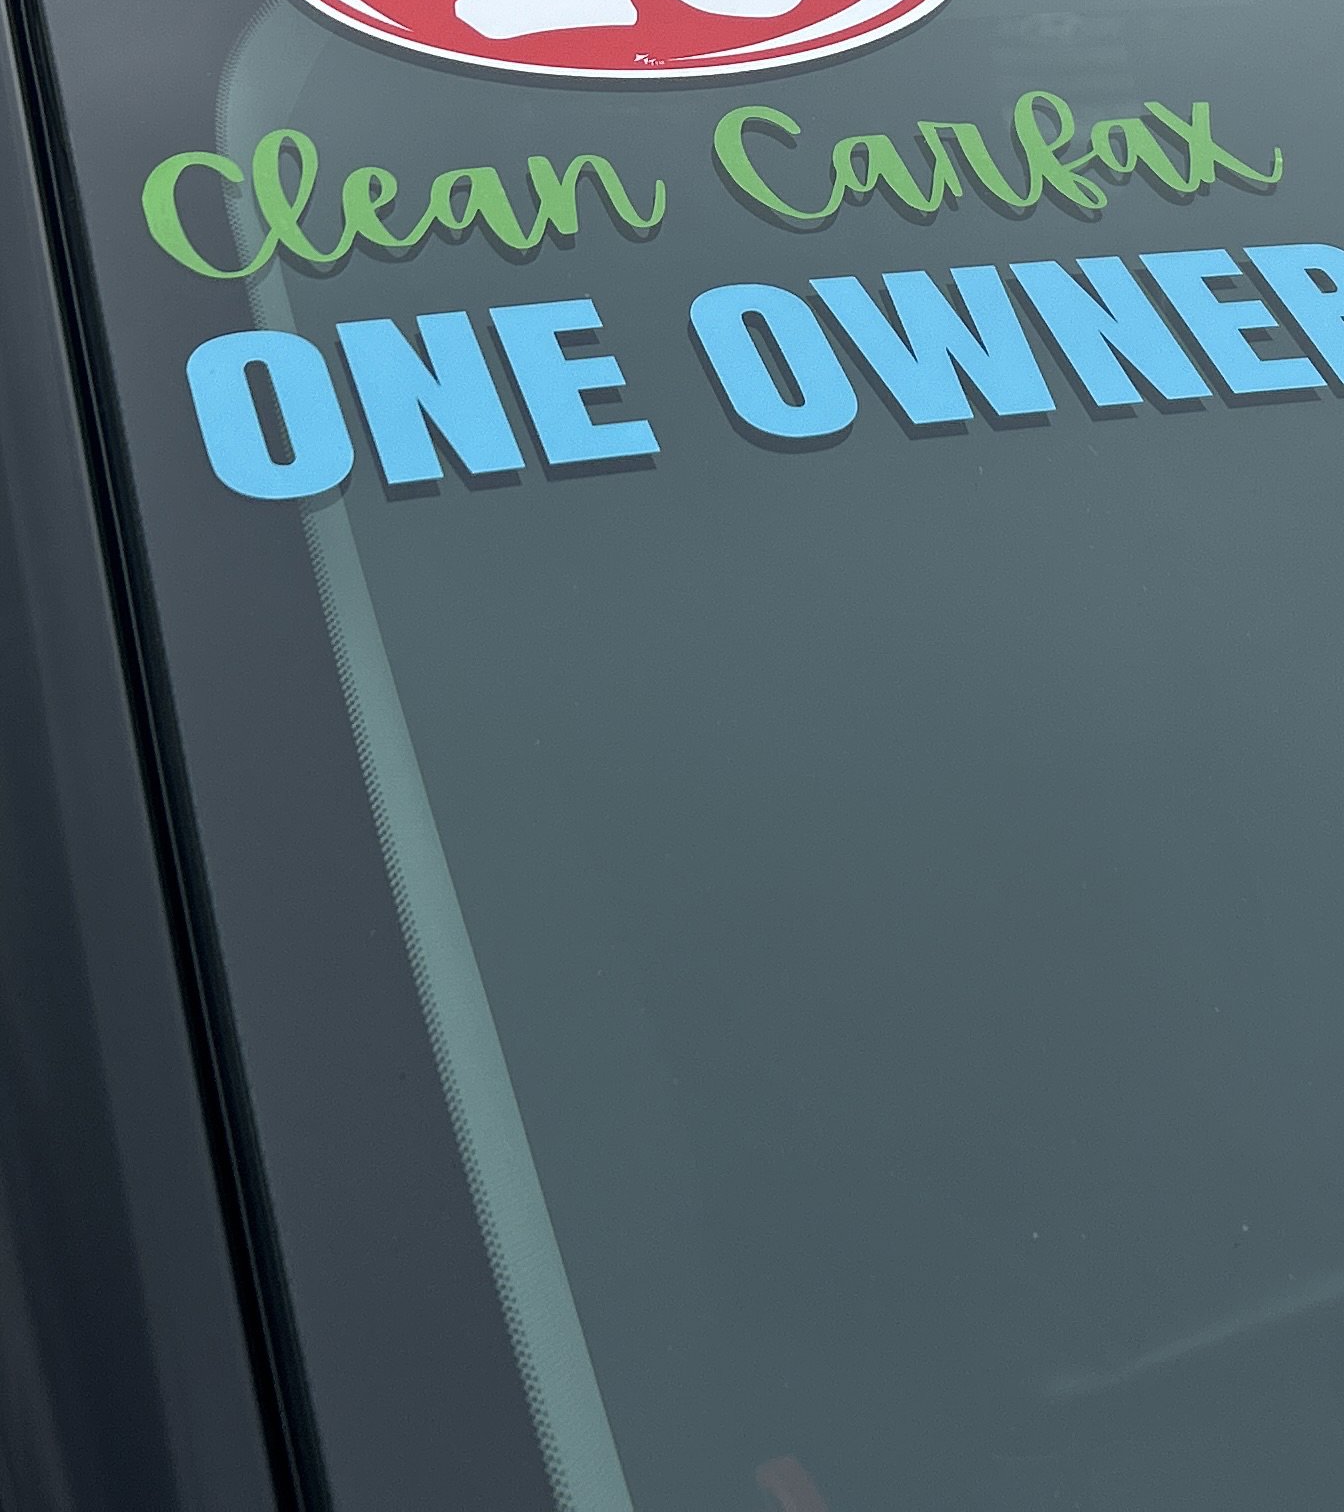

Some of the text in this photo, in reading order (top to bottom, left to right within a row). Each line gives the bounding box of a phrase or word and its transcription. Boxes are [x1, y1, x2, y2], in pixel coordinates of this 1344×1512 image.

[141, 90, 1284, 279] Clean Carfax
[186, 299, 660, 500] ONE
